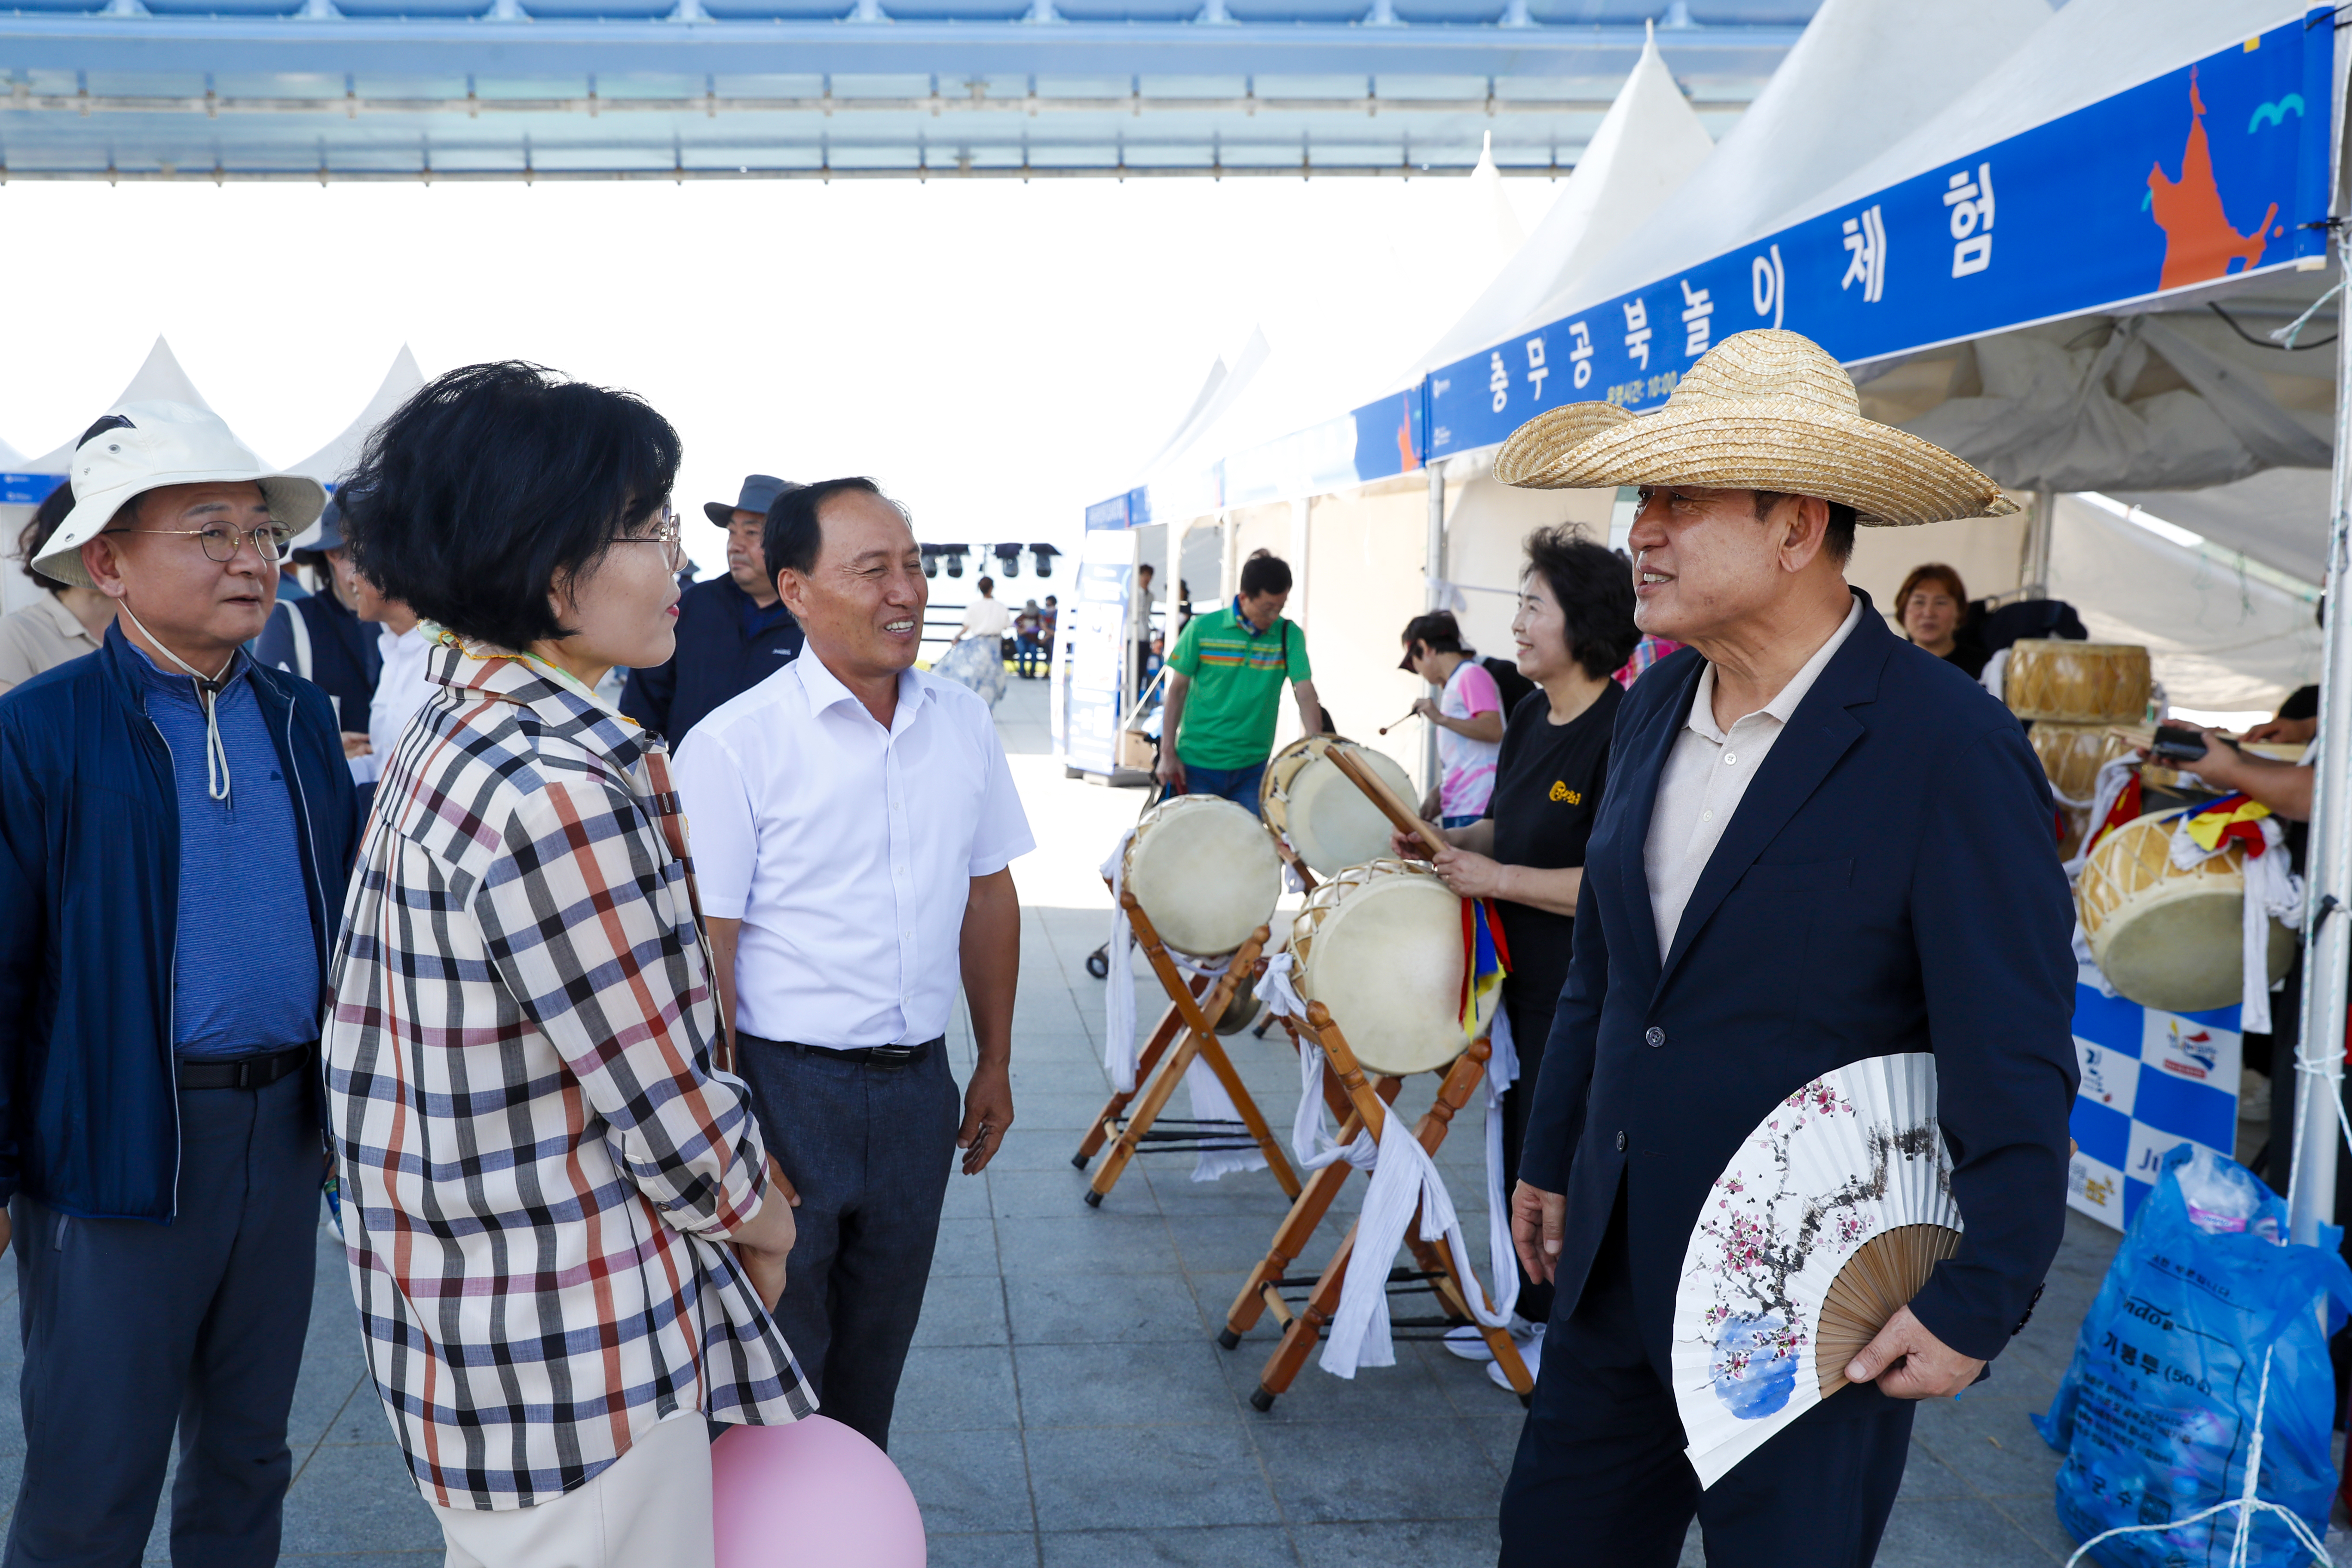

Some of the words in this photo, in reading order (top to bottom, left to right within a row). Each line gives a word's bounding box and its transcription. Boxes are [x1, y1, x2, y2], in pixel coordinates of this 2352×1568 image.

[1490, 321, 1594, 413] 충무공
[1623, 244, 1785, 371] 북놀이
[1841, 162, 1995, 303] 체험
